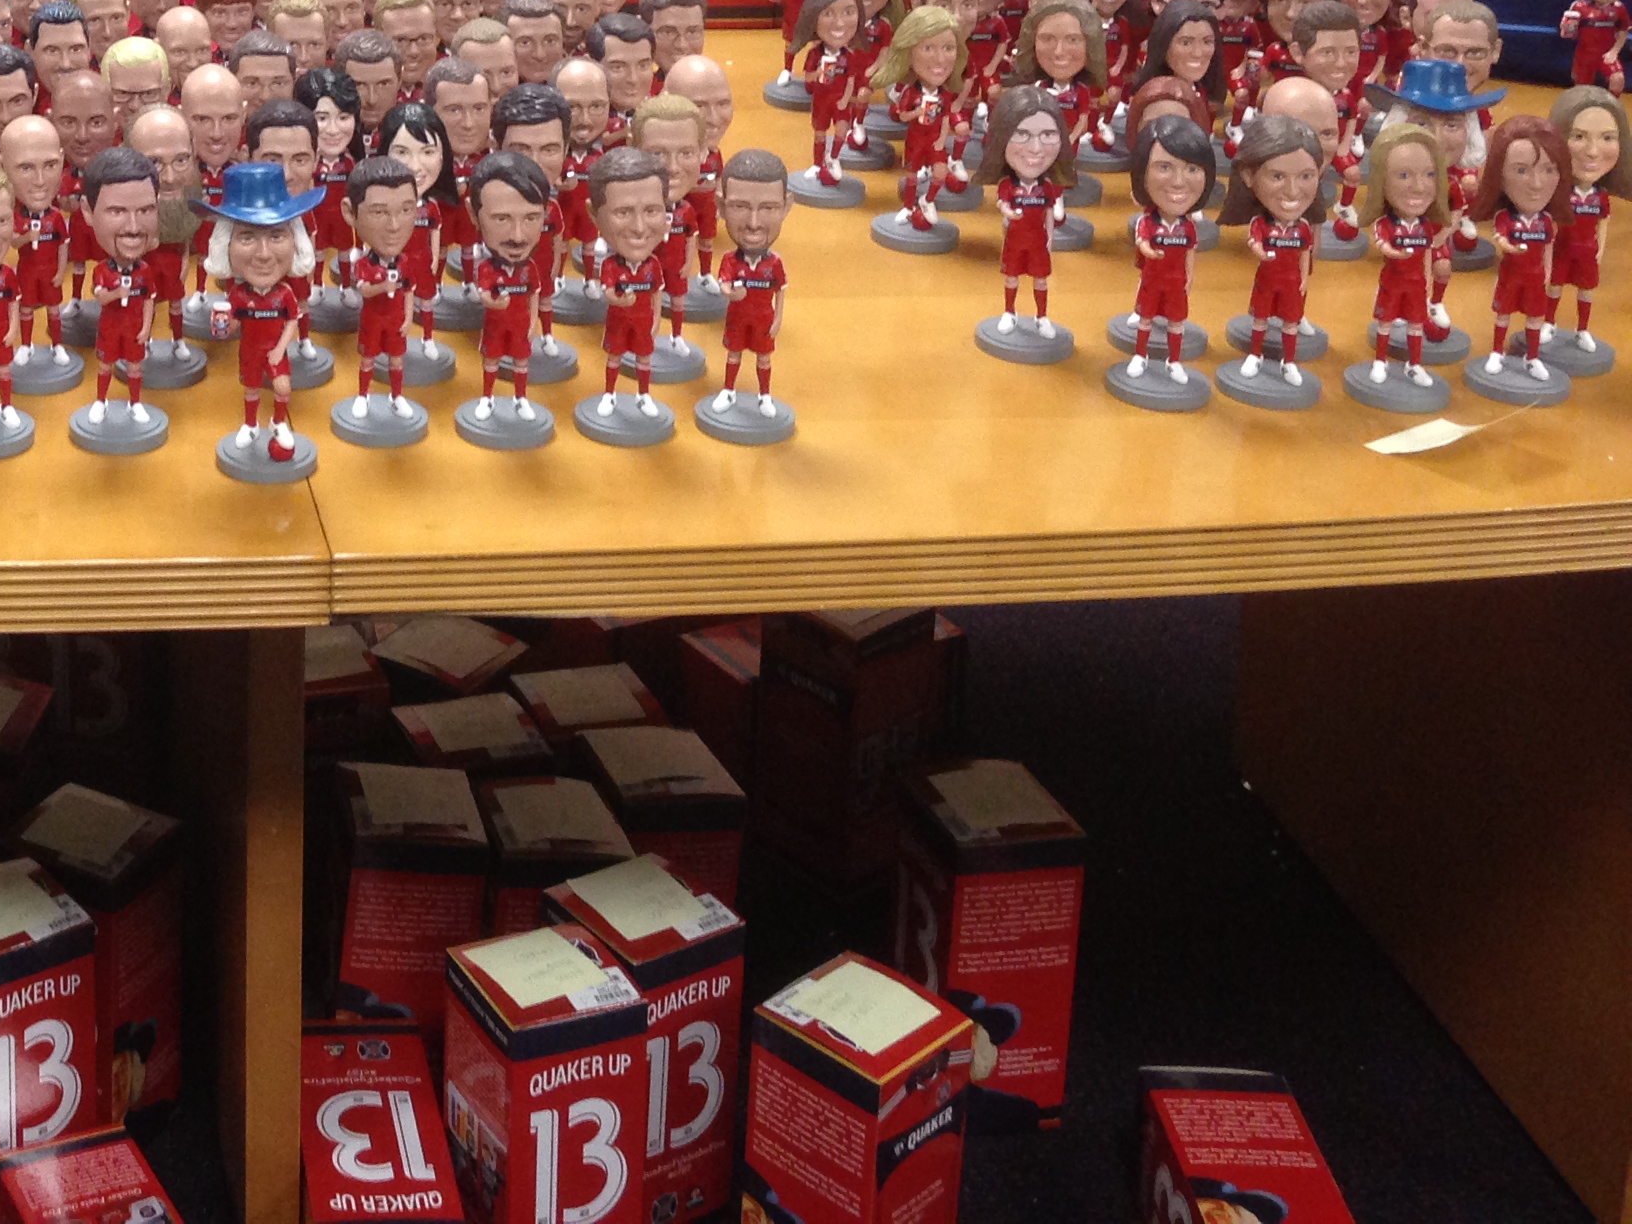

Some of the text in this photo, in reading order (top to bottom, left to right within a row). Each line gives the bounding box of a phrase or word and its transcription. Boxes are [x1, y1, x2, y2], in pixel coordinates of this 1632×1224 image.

[59, 974, 81, 997] UP
[646, 979, 708, 1026] QUAKER
[712, 975, 732, 998] UP
[530, 1053, 632, 1097] QUAKER UP
[646, 1020, 725, 1158] 13
[316, 1089, 436, 1183] 13
[907, 1106, 953, 1150] QUAKER
[530, 1096, 628, 1224] 13
[330, 1190, 443, 1213] QUAKER UP
